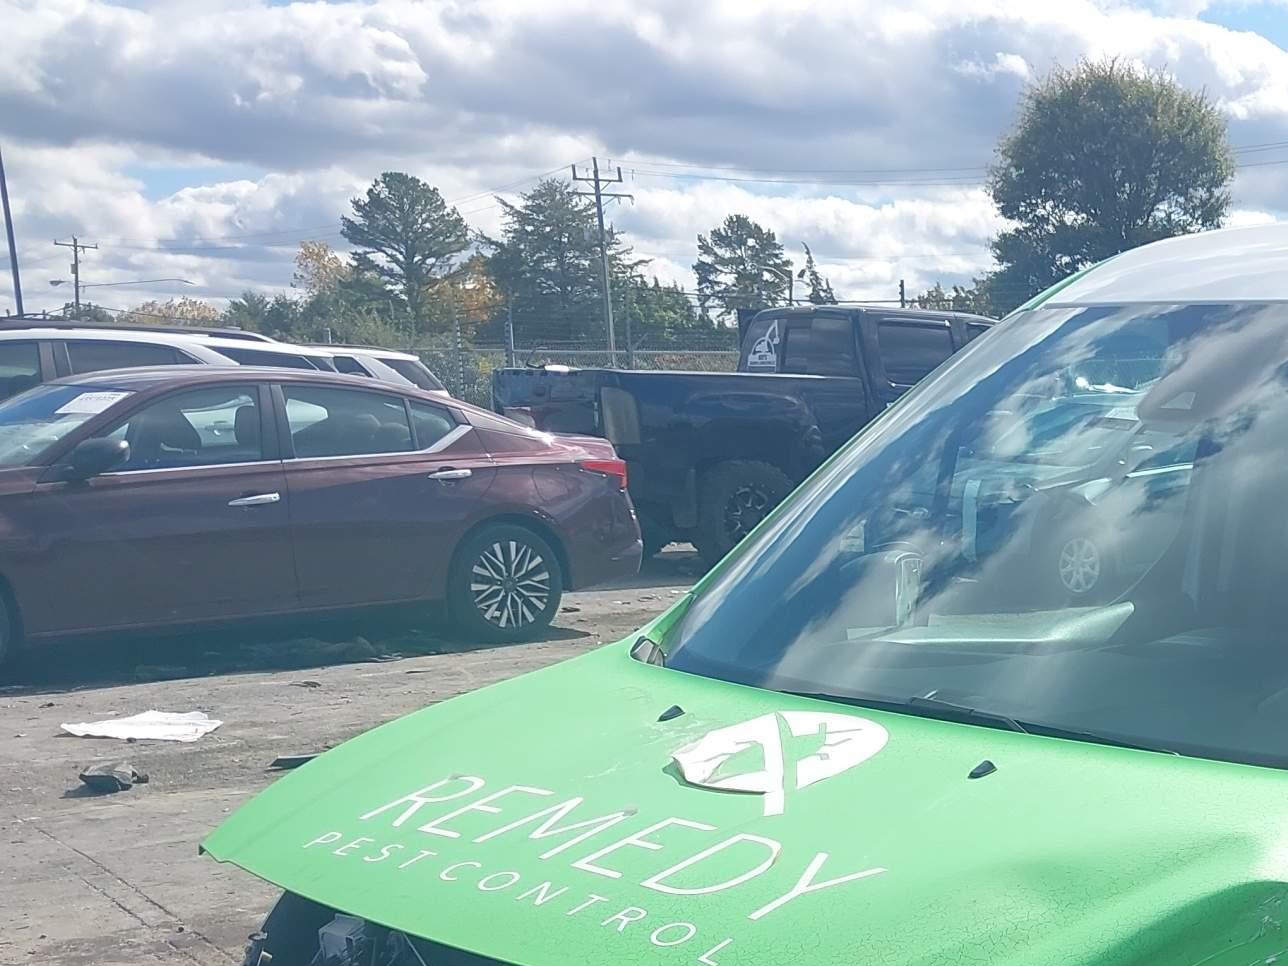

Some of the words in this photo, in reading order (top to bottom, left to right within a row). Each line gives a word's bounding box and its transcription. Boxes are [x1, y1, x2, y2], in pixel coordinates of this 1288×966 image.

[303, 831, 438, 869] PEST
[439, 861, 734, 966] CONTROL
[359, 775, 889, 921] REMEDY
